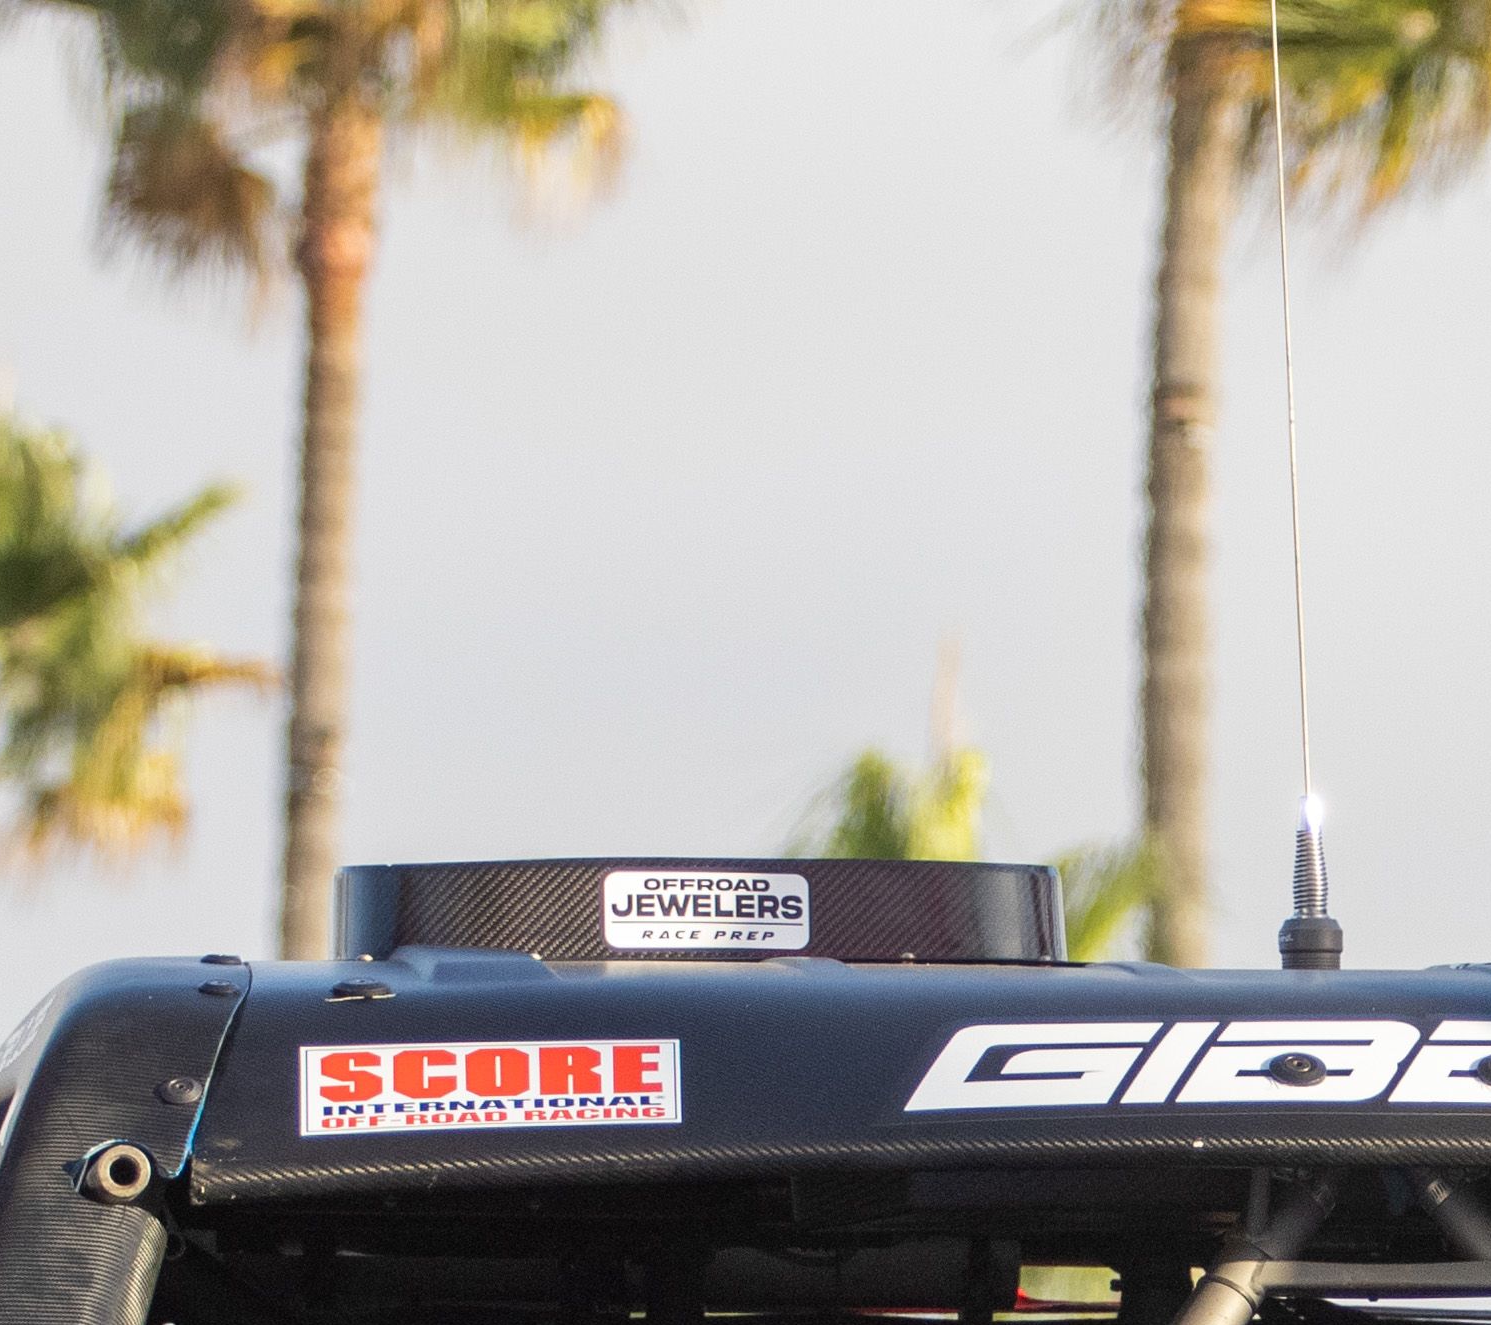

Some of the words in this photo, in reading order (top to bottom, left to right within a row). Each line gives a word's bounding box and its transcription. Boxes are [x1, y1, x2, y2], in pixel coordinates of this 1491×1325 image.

[644, 878, 770, 893] OFFROAD
[612, 894, 803, 919] JEWELERS
[642, 930, 701, 940] RACE
[714, 930, 775, 941] PREP
[320, 1045, 663, 1102] SCORE
[323, 1095, 661, 1116] INTERNATIONAL
[321, 1111, 508, 1129] OFF-ROAD
[523, 1107, 666, 1121] RACING
